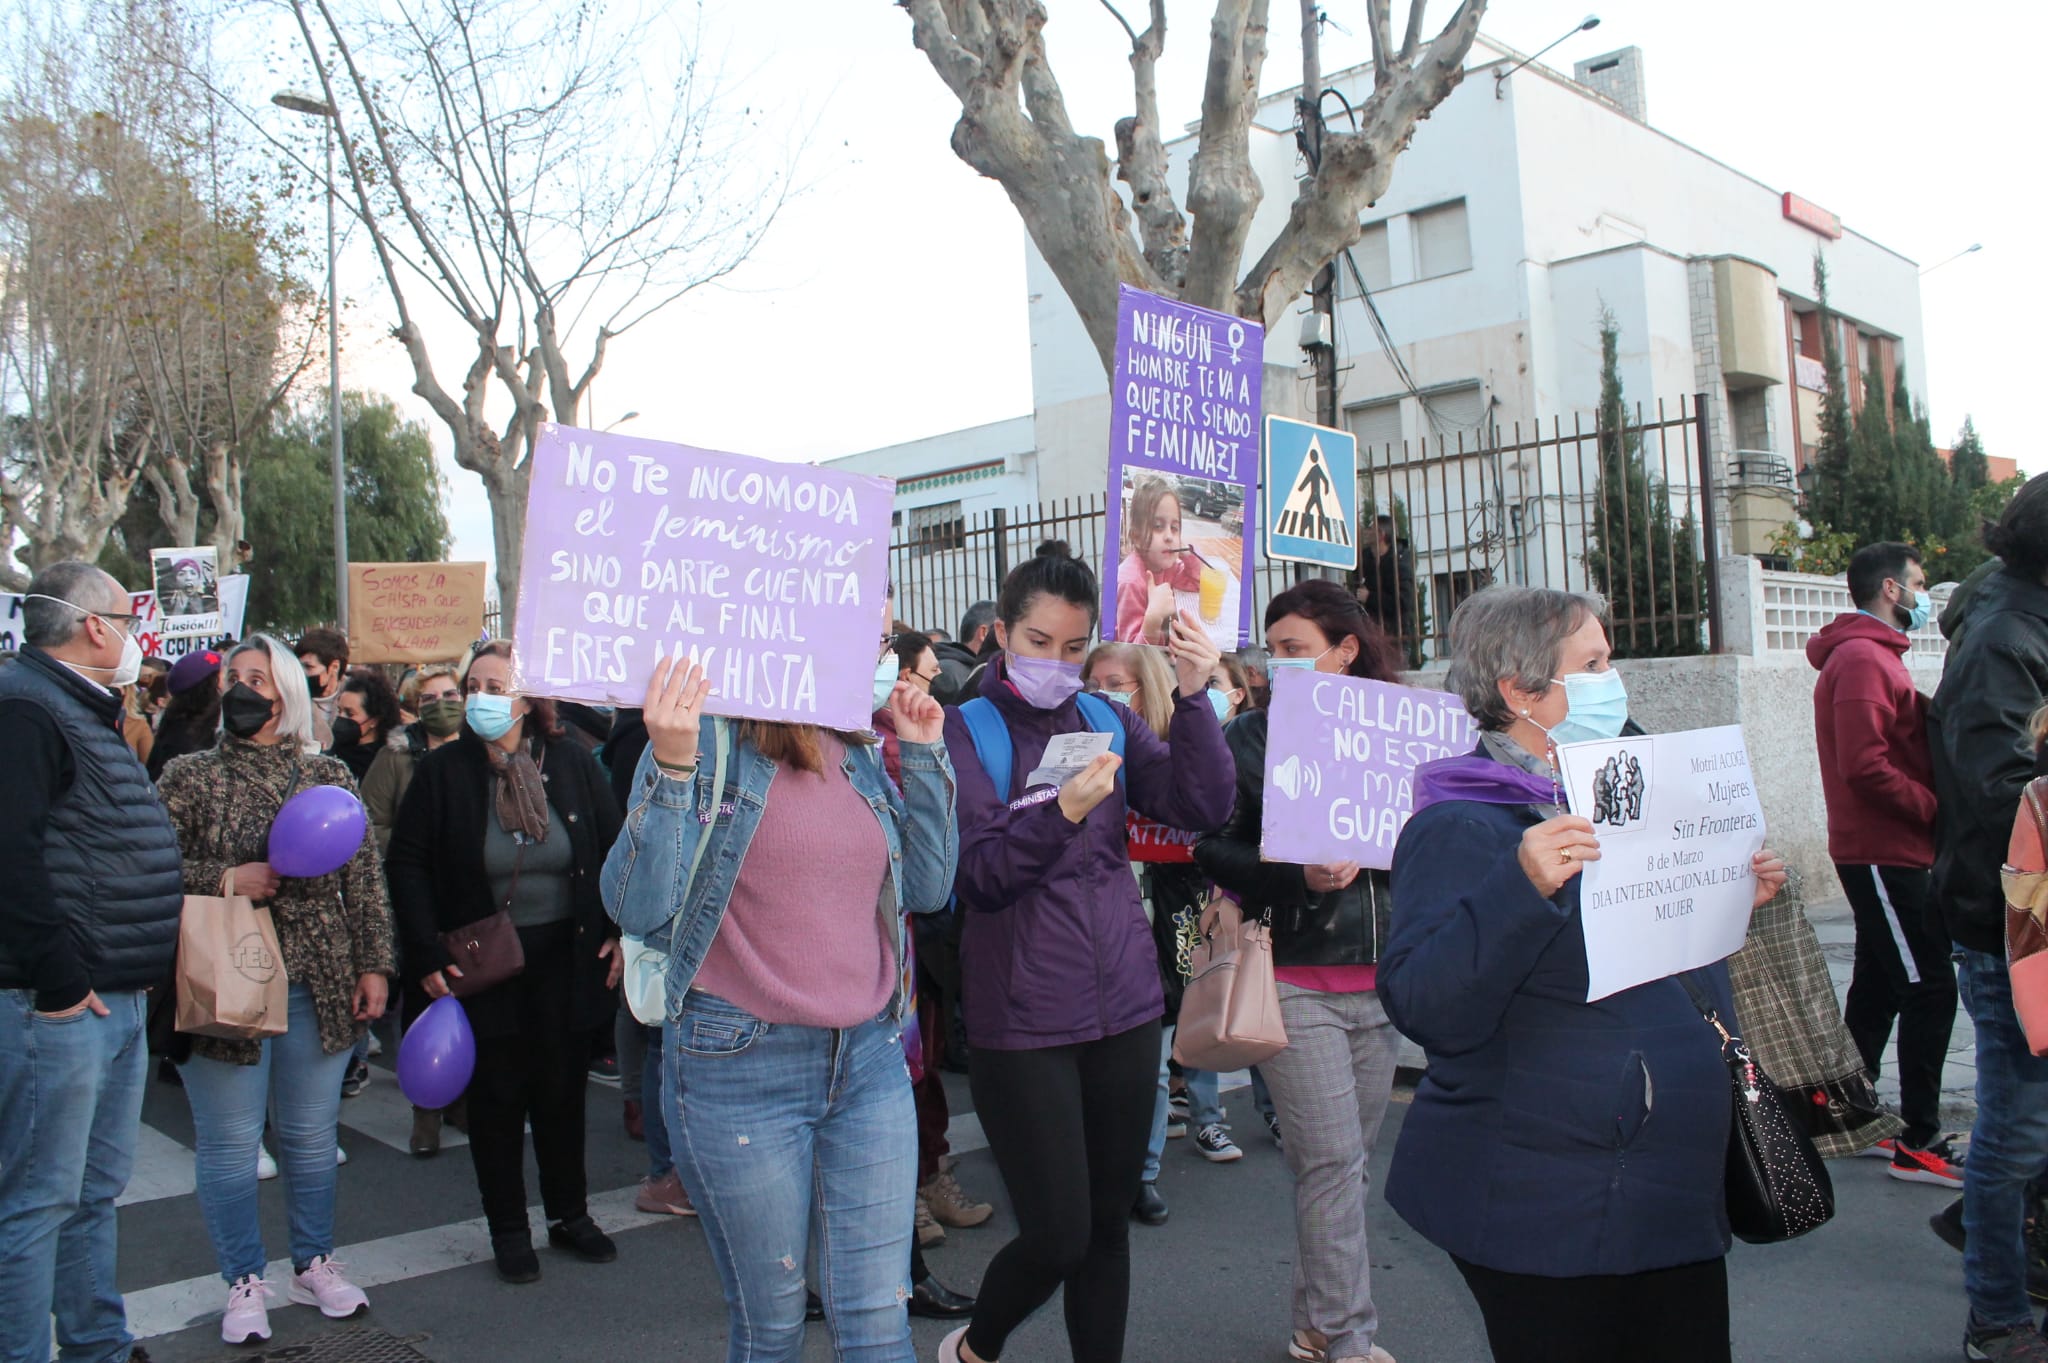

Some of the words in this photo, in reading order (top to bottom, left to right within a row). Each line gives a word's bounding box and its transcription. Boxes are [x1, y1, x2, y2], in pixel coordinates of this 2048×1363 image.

[1133, 310, 1212, 363] NINGÚN
[1128, 348, 1190, 390] HOMBRE
[1197, 365, 1214, 398] TE
[1218, 366, 1234, 401] VA
[1239, 376, 1250, 406] A
[1126, 382, 1195, 426] QUERER
[1202, 401, 1251, 439] SIENDO
[1128, 414, 1239, 480] FEMINAZI
[566, 441, 616, 493] NO
[689, 466, 858, 526] INCOMODA
[574, 498, 615, 537] el
[641, 504, 873, 568] feminismo
[434, 594, 460, 607] QUE
[551, 550, 622, 588] SINO
[744, 567, 861, 607] CUENTA
[583, 592, 649, 630] QUE
[665, 600, 705, 635] AL
[719, 603, 806, 643] FINAL
[545, 628, 635, 686] ERES
[1334, 728, 1371, 762] NO
[1690, 754, 1718, 775] Motril
[1720, 750, 1746, 769] ACOGE
[1708, 780, 1751, 806] Mujeres
[1672, 818, 1695, 841] Sin
[1699, 812, 1758, 836] Fronteras
[1647, 856, 1654, 872] 8
[1657, 855, 1670, 869] de
[1672, 850, 1704, 867] Marzo
[1592, 890, 1613, 910] DIA
[1615, 871, 1718, 904] INTERNACIONAL
[1722, 865, 1738, 883] DE
[1654, 899, 1694, 921] MUJER
